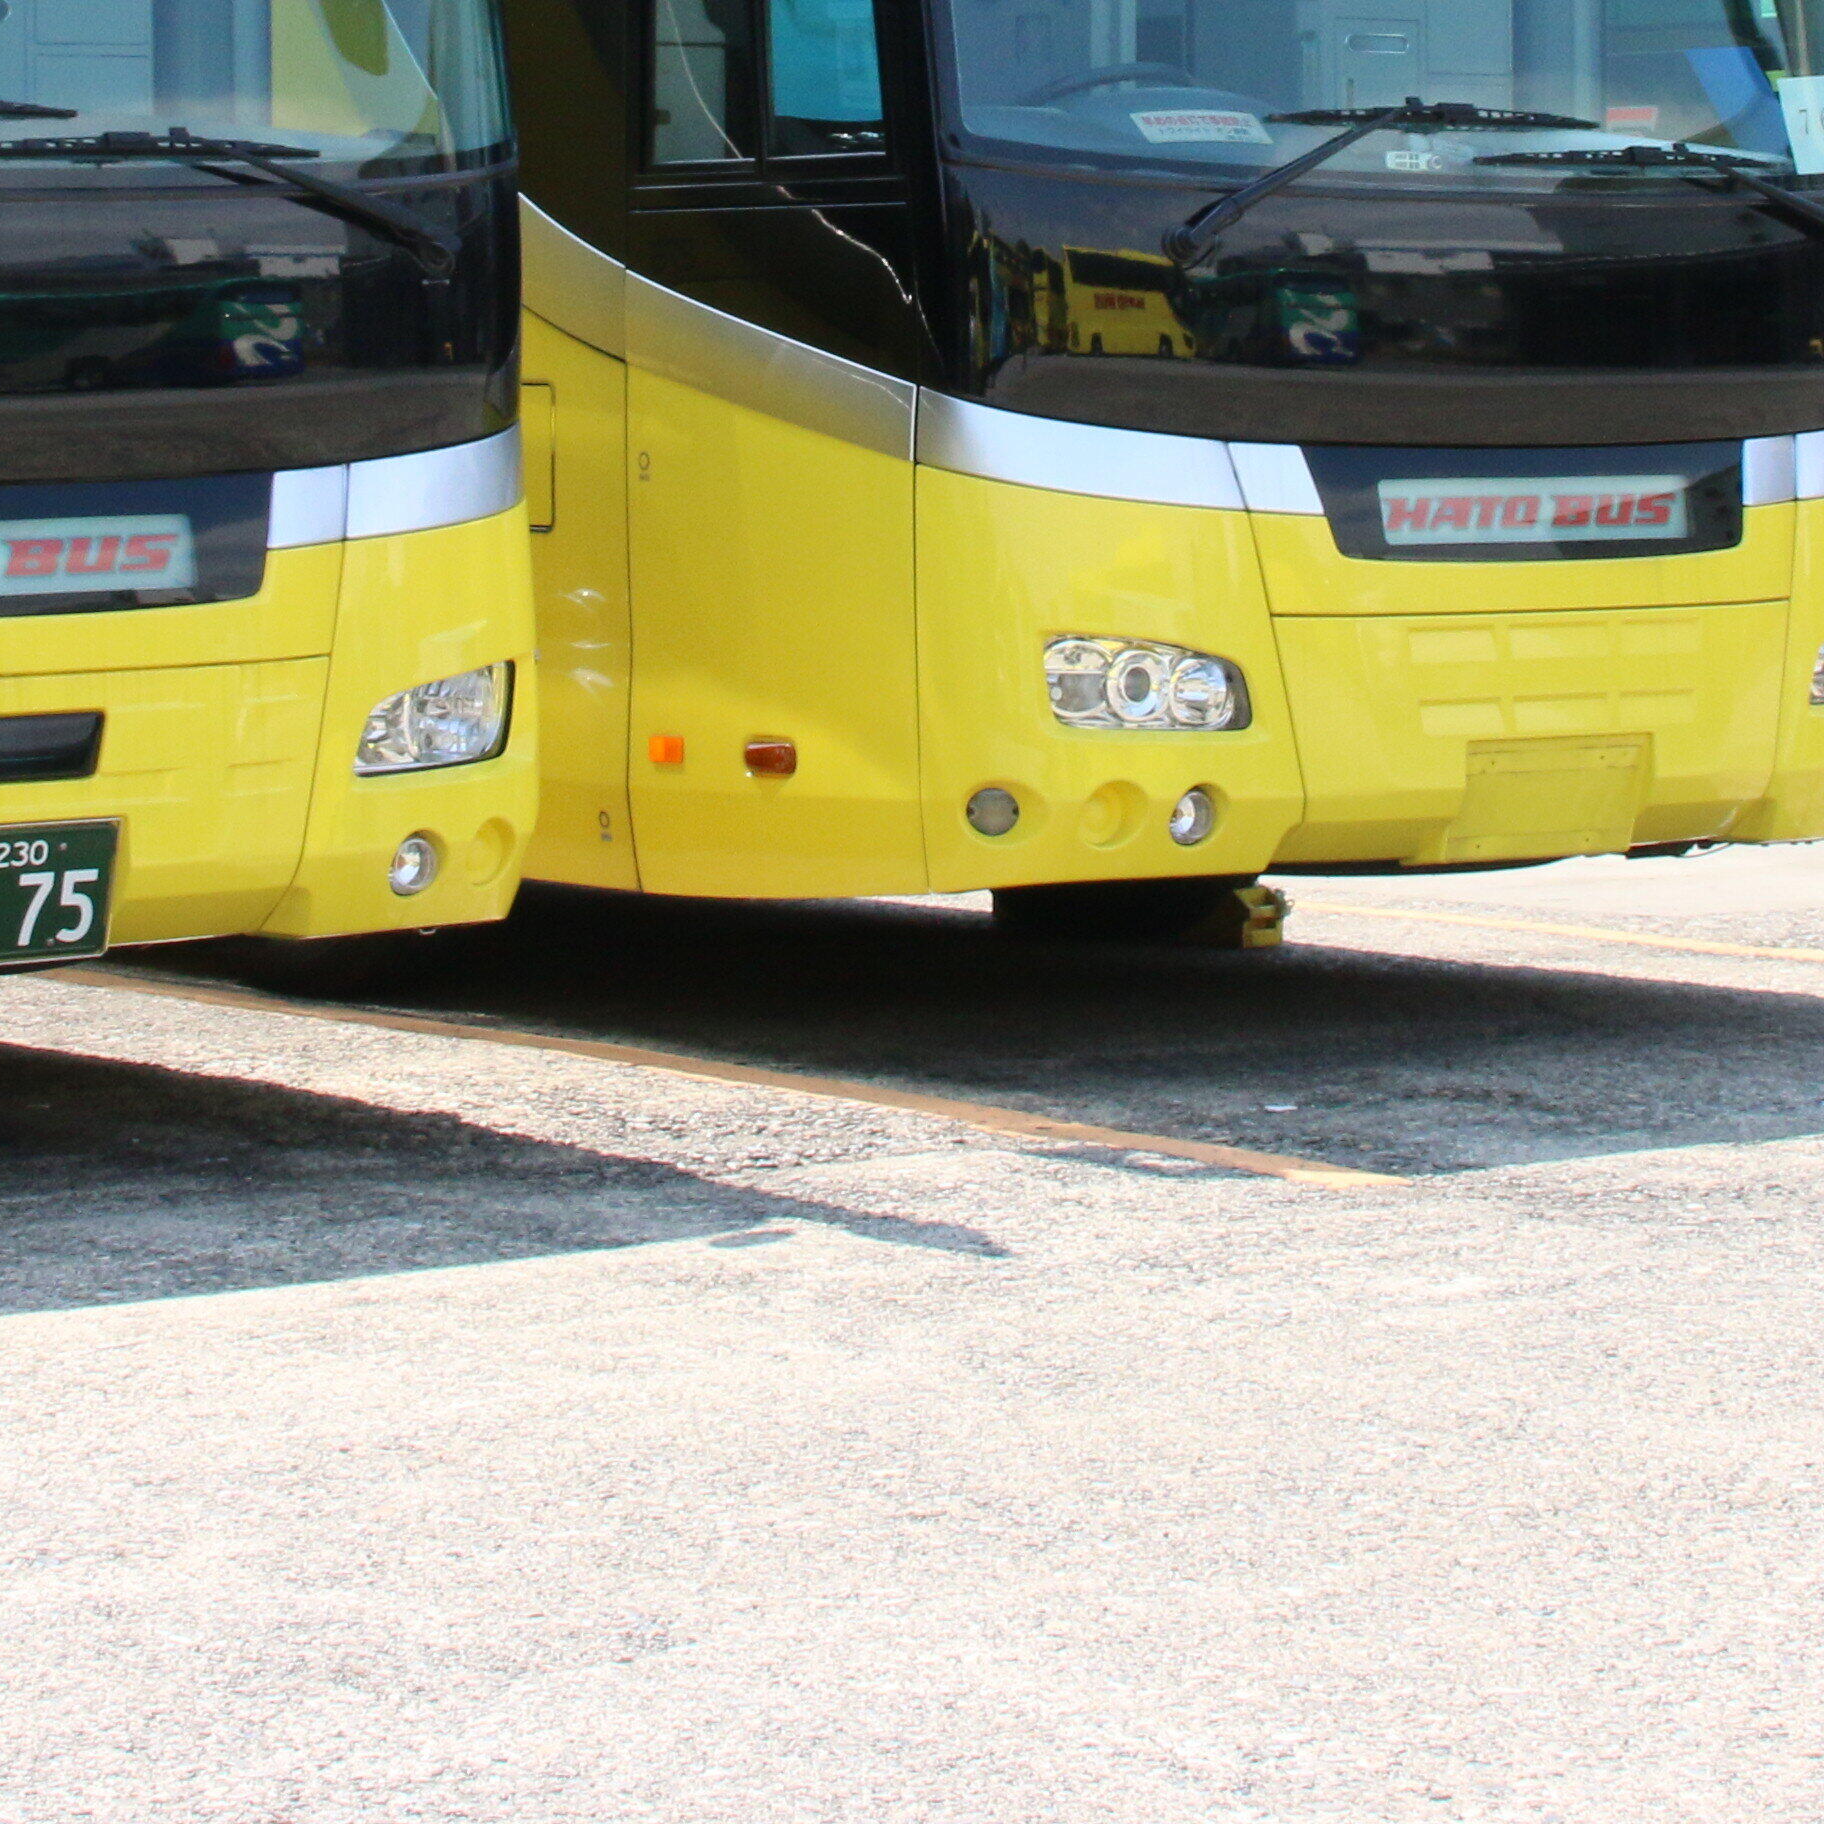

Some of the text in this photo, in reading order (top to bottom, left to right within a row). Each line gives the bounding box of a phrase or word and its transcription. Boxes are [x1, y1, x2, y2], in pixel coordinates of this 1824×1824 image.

[1383, 492, 1675, 530] HATO BUS
[3, 533, 179, 576] BUS
